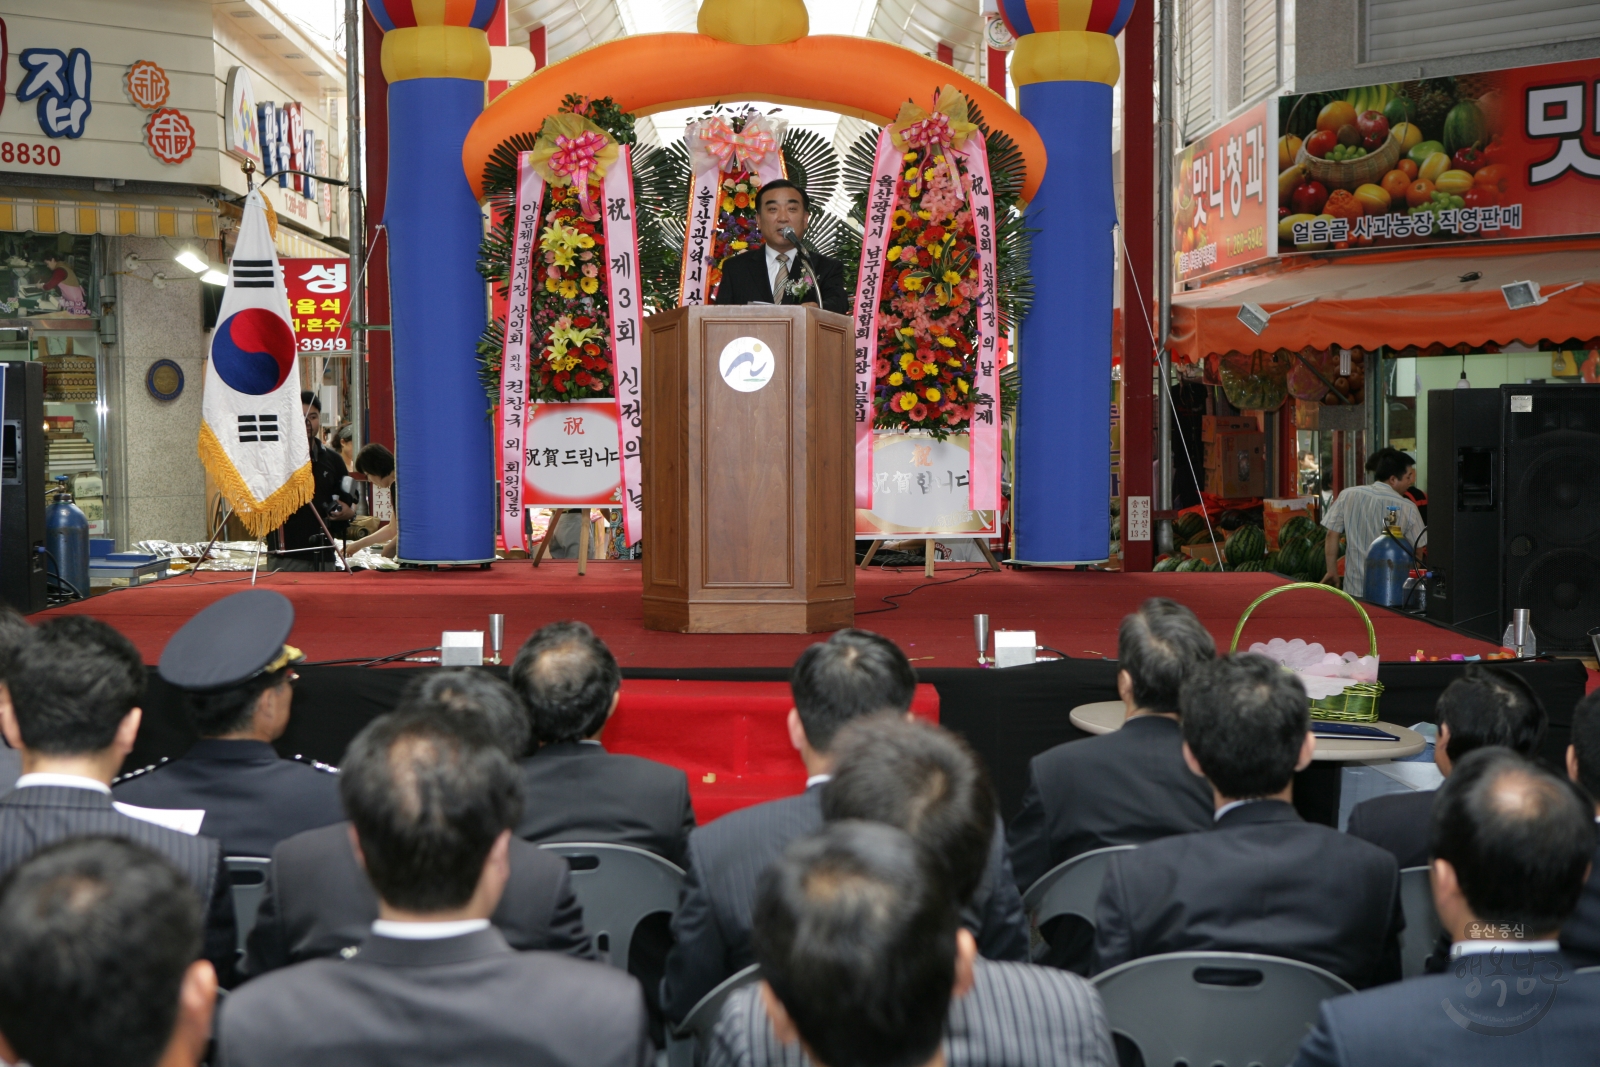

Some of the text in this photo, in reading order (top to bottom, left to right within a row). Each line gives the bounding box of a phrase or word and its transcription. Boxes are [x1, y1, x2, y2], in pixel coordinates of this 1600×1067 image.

[16, 48, 92, 138] 집
[971, 174, 989, 196] 祝
[1192, 124, 1265, 228] 맛나청과
[607, 197, 631, 222] 祝
[868, 174, 896, 239] 울산광역시
[687, 185, 714, 283] 울산광역시
[976, 205, 992, 254] 제3회
[1292, 204, 1522, 244] 얼음골 사과농장 직영판매
[280, 264, 347, 293] 성
[855, 245, 882, 340] 남구상인연합회
[288, 298, 340, 314] 음식
[508, 303, 528, 346] 상인회
[509, 354, 522, 371] 회장
[855, 346, 870, 374] 회장
[975, 392, 995, 426] 축제
[563, 417, 585, 436] 祝
[504, 437, 520, 451] 외
[909, 443, 933, 467] 祝
[504, 460, 520, 517] 회원일동
